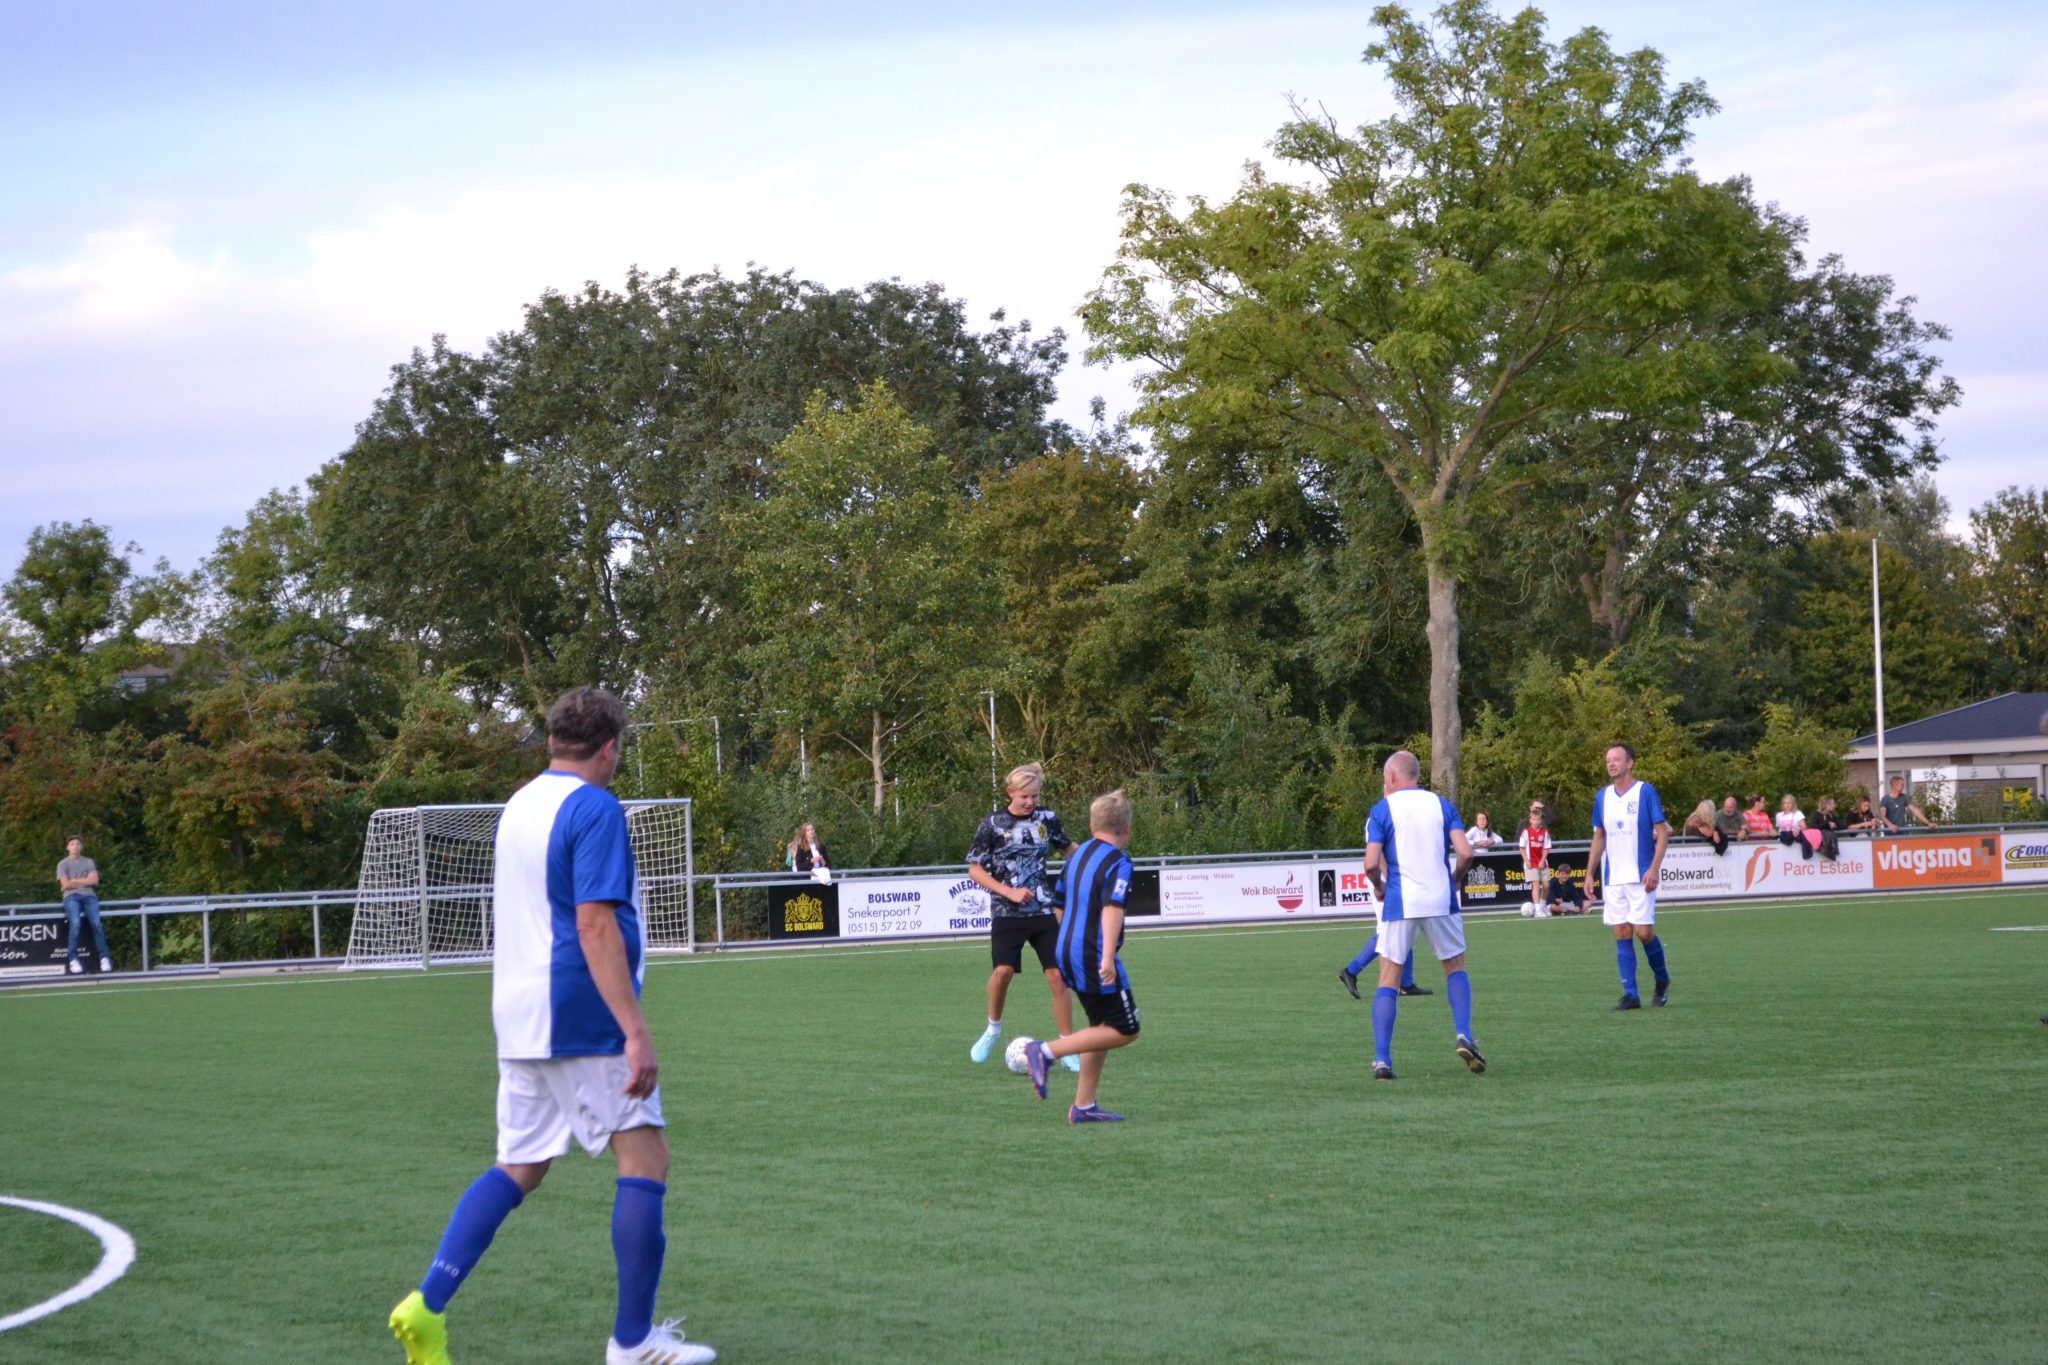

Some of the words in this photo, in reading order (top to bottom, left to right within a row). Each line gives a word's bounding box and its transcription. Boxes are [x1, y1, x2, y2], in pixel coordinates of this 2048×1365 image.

[1878, 844, 1972, 875] vlagsma
[1661, 867, 1714, 881] Bolsward
[1784, 862, 1815, 876] Parc
[1820, 860, 1864, 875] Estate
[1241, 886, 1260, 896] Wok
[1262, 884, 1303, 895] Bolsward
[1505, 883, 1523, 891] Word
[868, 892, 921, 904] BOLSWARD
[848, 905, 910, 920] Snekerpoort
[914, 904, 921, 916] 7
[785, 923, 793, 932] SC
[794, 921, 824, 931] BOLSWARD
[848, 922, 878, 934] (0515)
[881, 921, 893, 931] 57
[896, 920, 907, 931] 22
[909, 920, 922, 930] 09
[950, 918, 968, 929] FISH
[971, 917, 992, 928] CHIP
[0, 924, 57, 942] IKSEN
